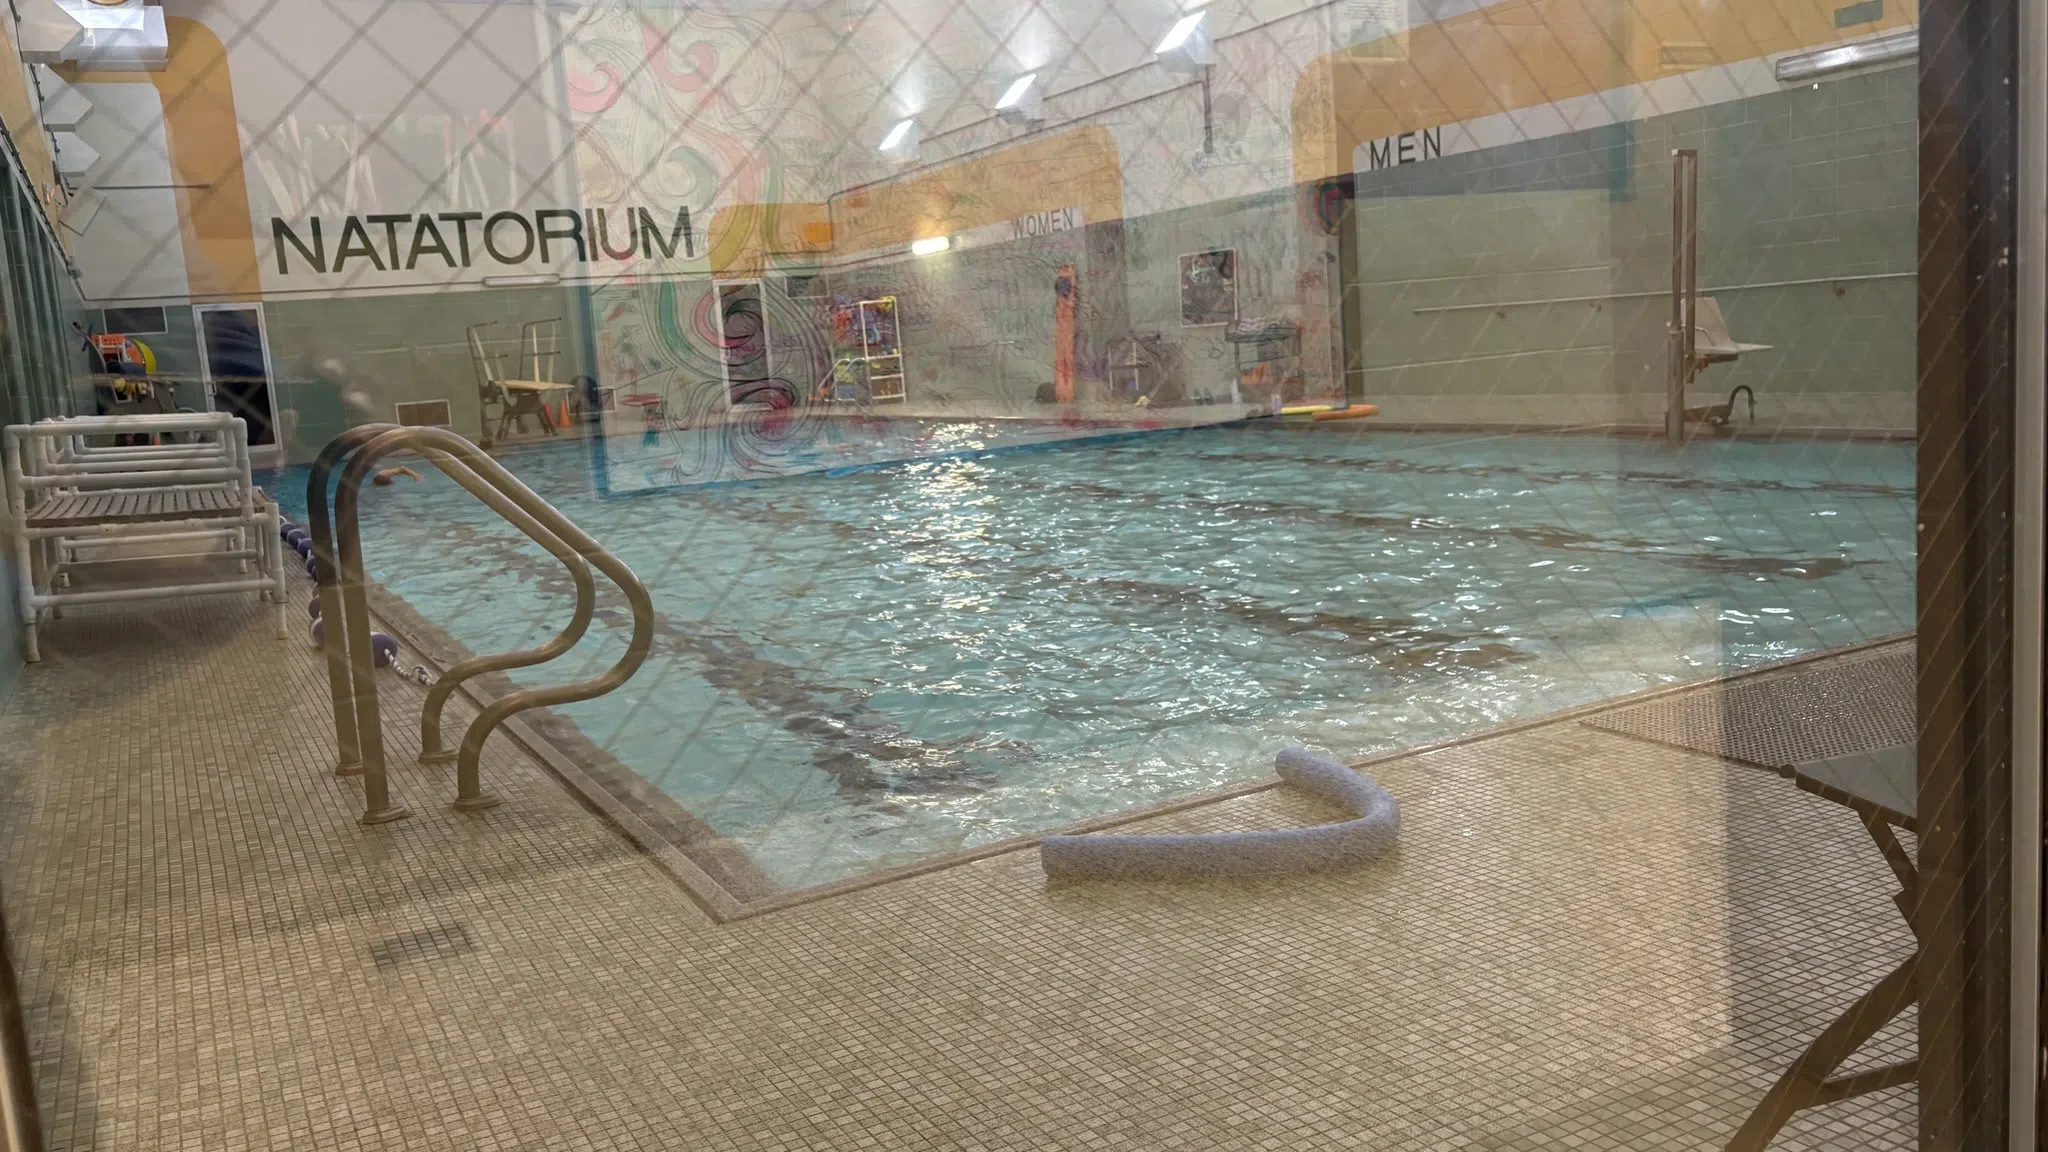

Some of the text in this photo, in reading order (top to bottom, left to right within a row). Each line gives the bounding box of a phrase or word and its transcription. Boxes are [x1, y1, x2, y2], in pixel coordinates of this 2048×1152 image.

[1369, 126, 1441, 170] MEN
[271, 205, 694, 275] NATATORIUM
[1011, 207, 1073, 240] WOMEN
